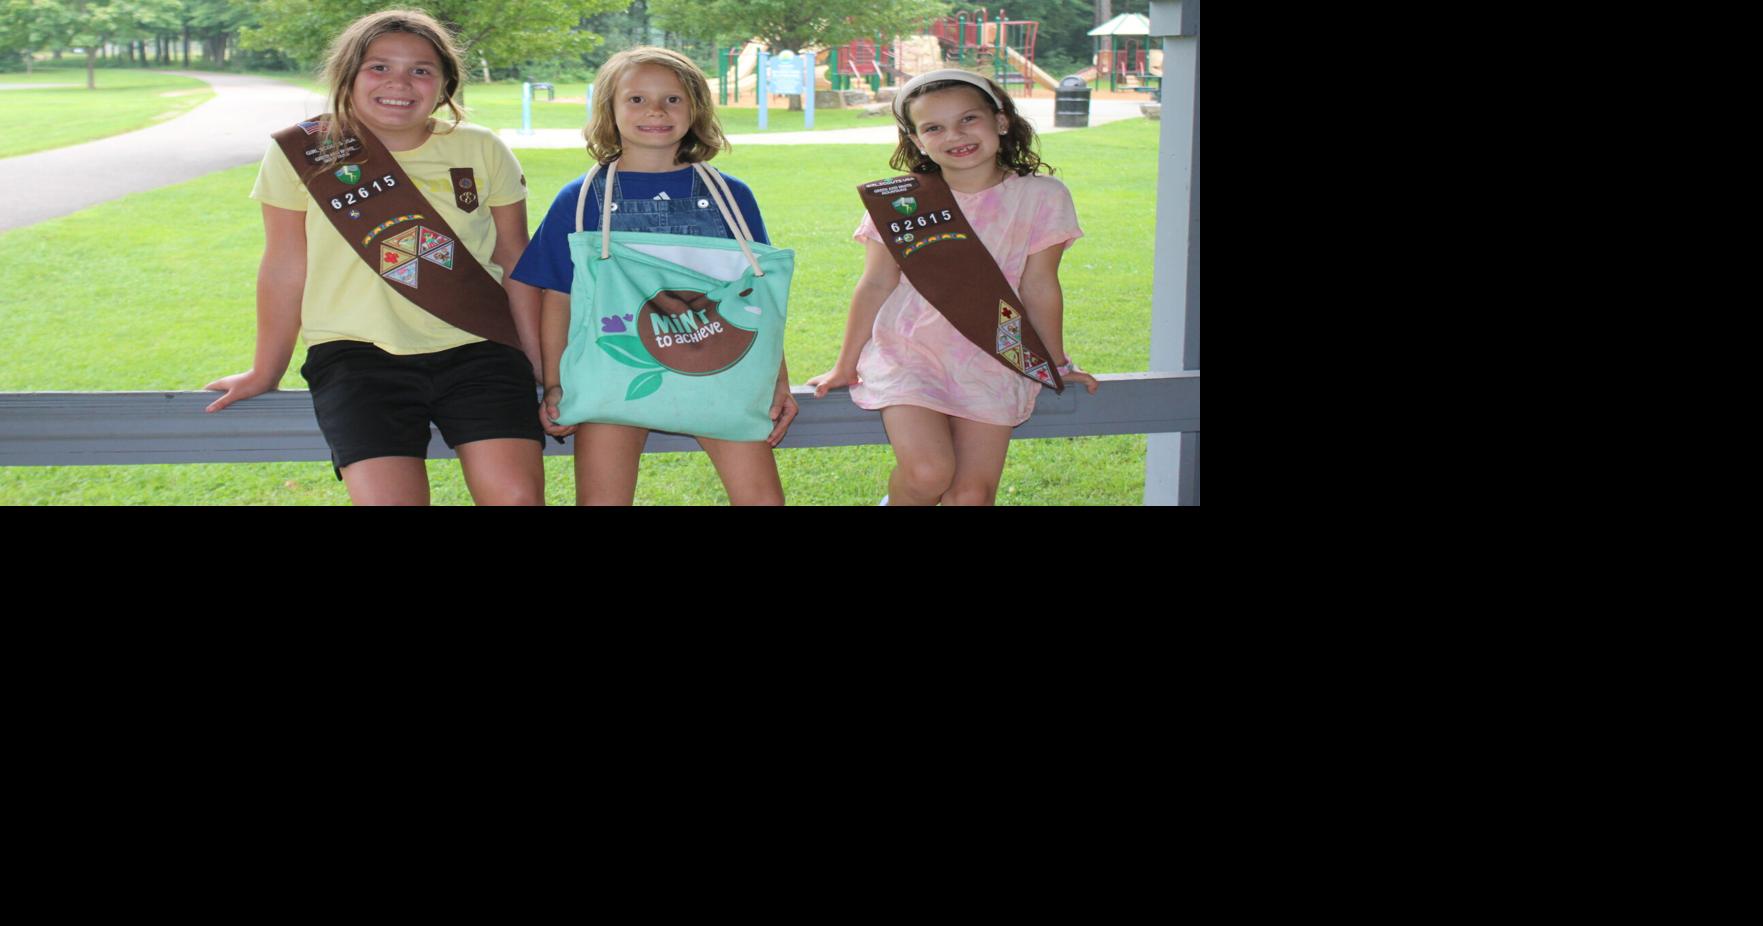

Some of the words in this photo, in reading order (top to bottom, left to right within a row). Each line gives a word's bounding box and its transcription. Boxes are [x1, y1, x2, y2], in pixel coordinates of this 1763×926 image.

[331, 175, 396, 210] 62615
[890, 210, 952, 233] 62615
[655, 334, 673, 348] to
